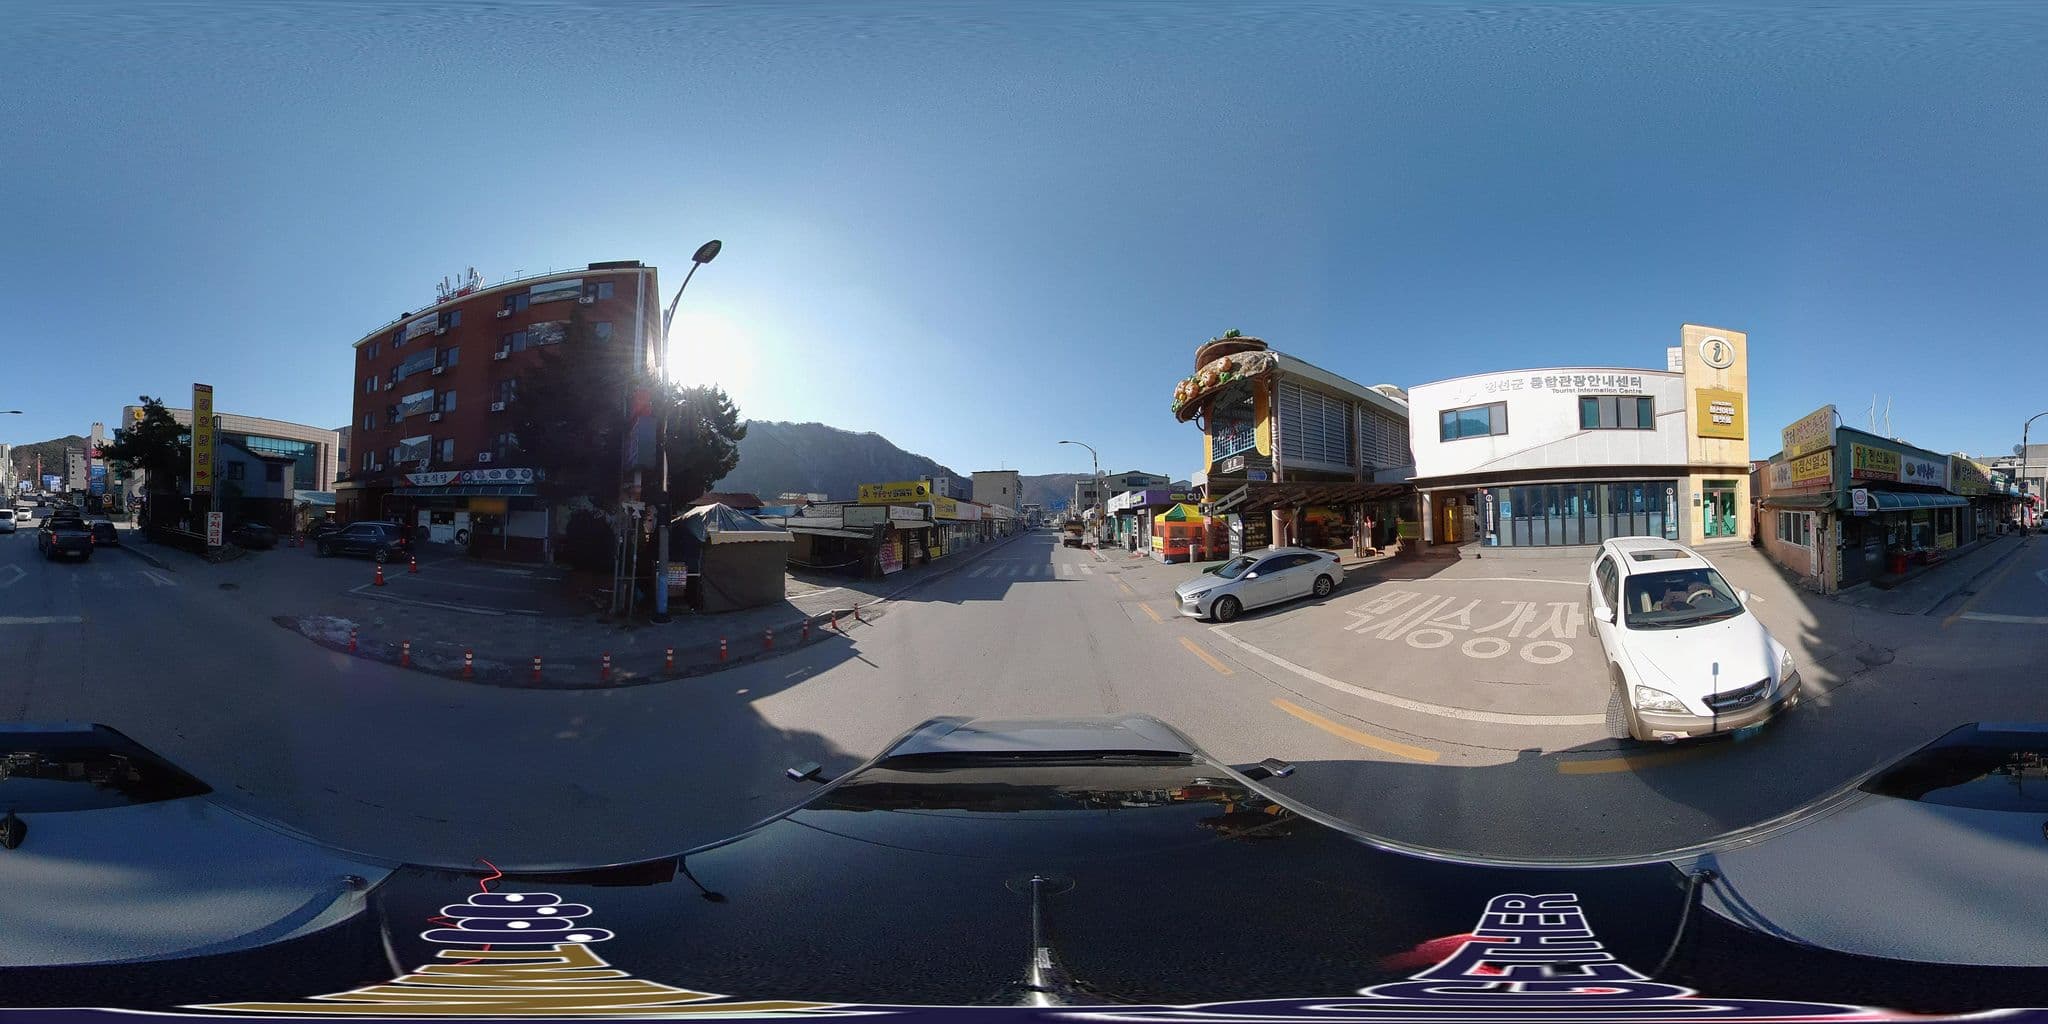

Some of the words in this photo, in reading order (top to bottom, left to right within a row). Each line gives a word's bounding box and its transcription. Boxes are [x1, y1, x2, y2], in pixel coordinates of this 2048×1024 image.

[1485, 378, 1524, 393] 정선군
[1530, 375, 1643, 388] 통합관광안내센터
[1187, 493, 1201, 501] CU
[1344, 591, 1585, 664] 택시승강장
